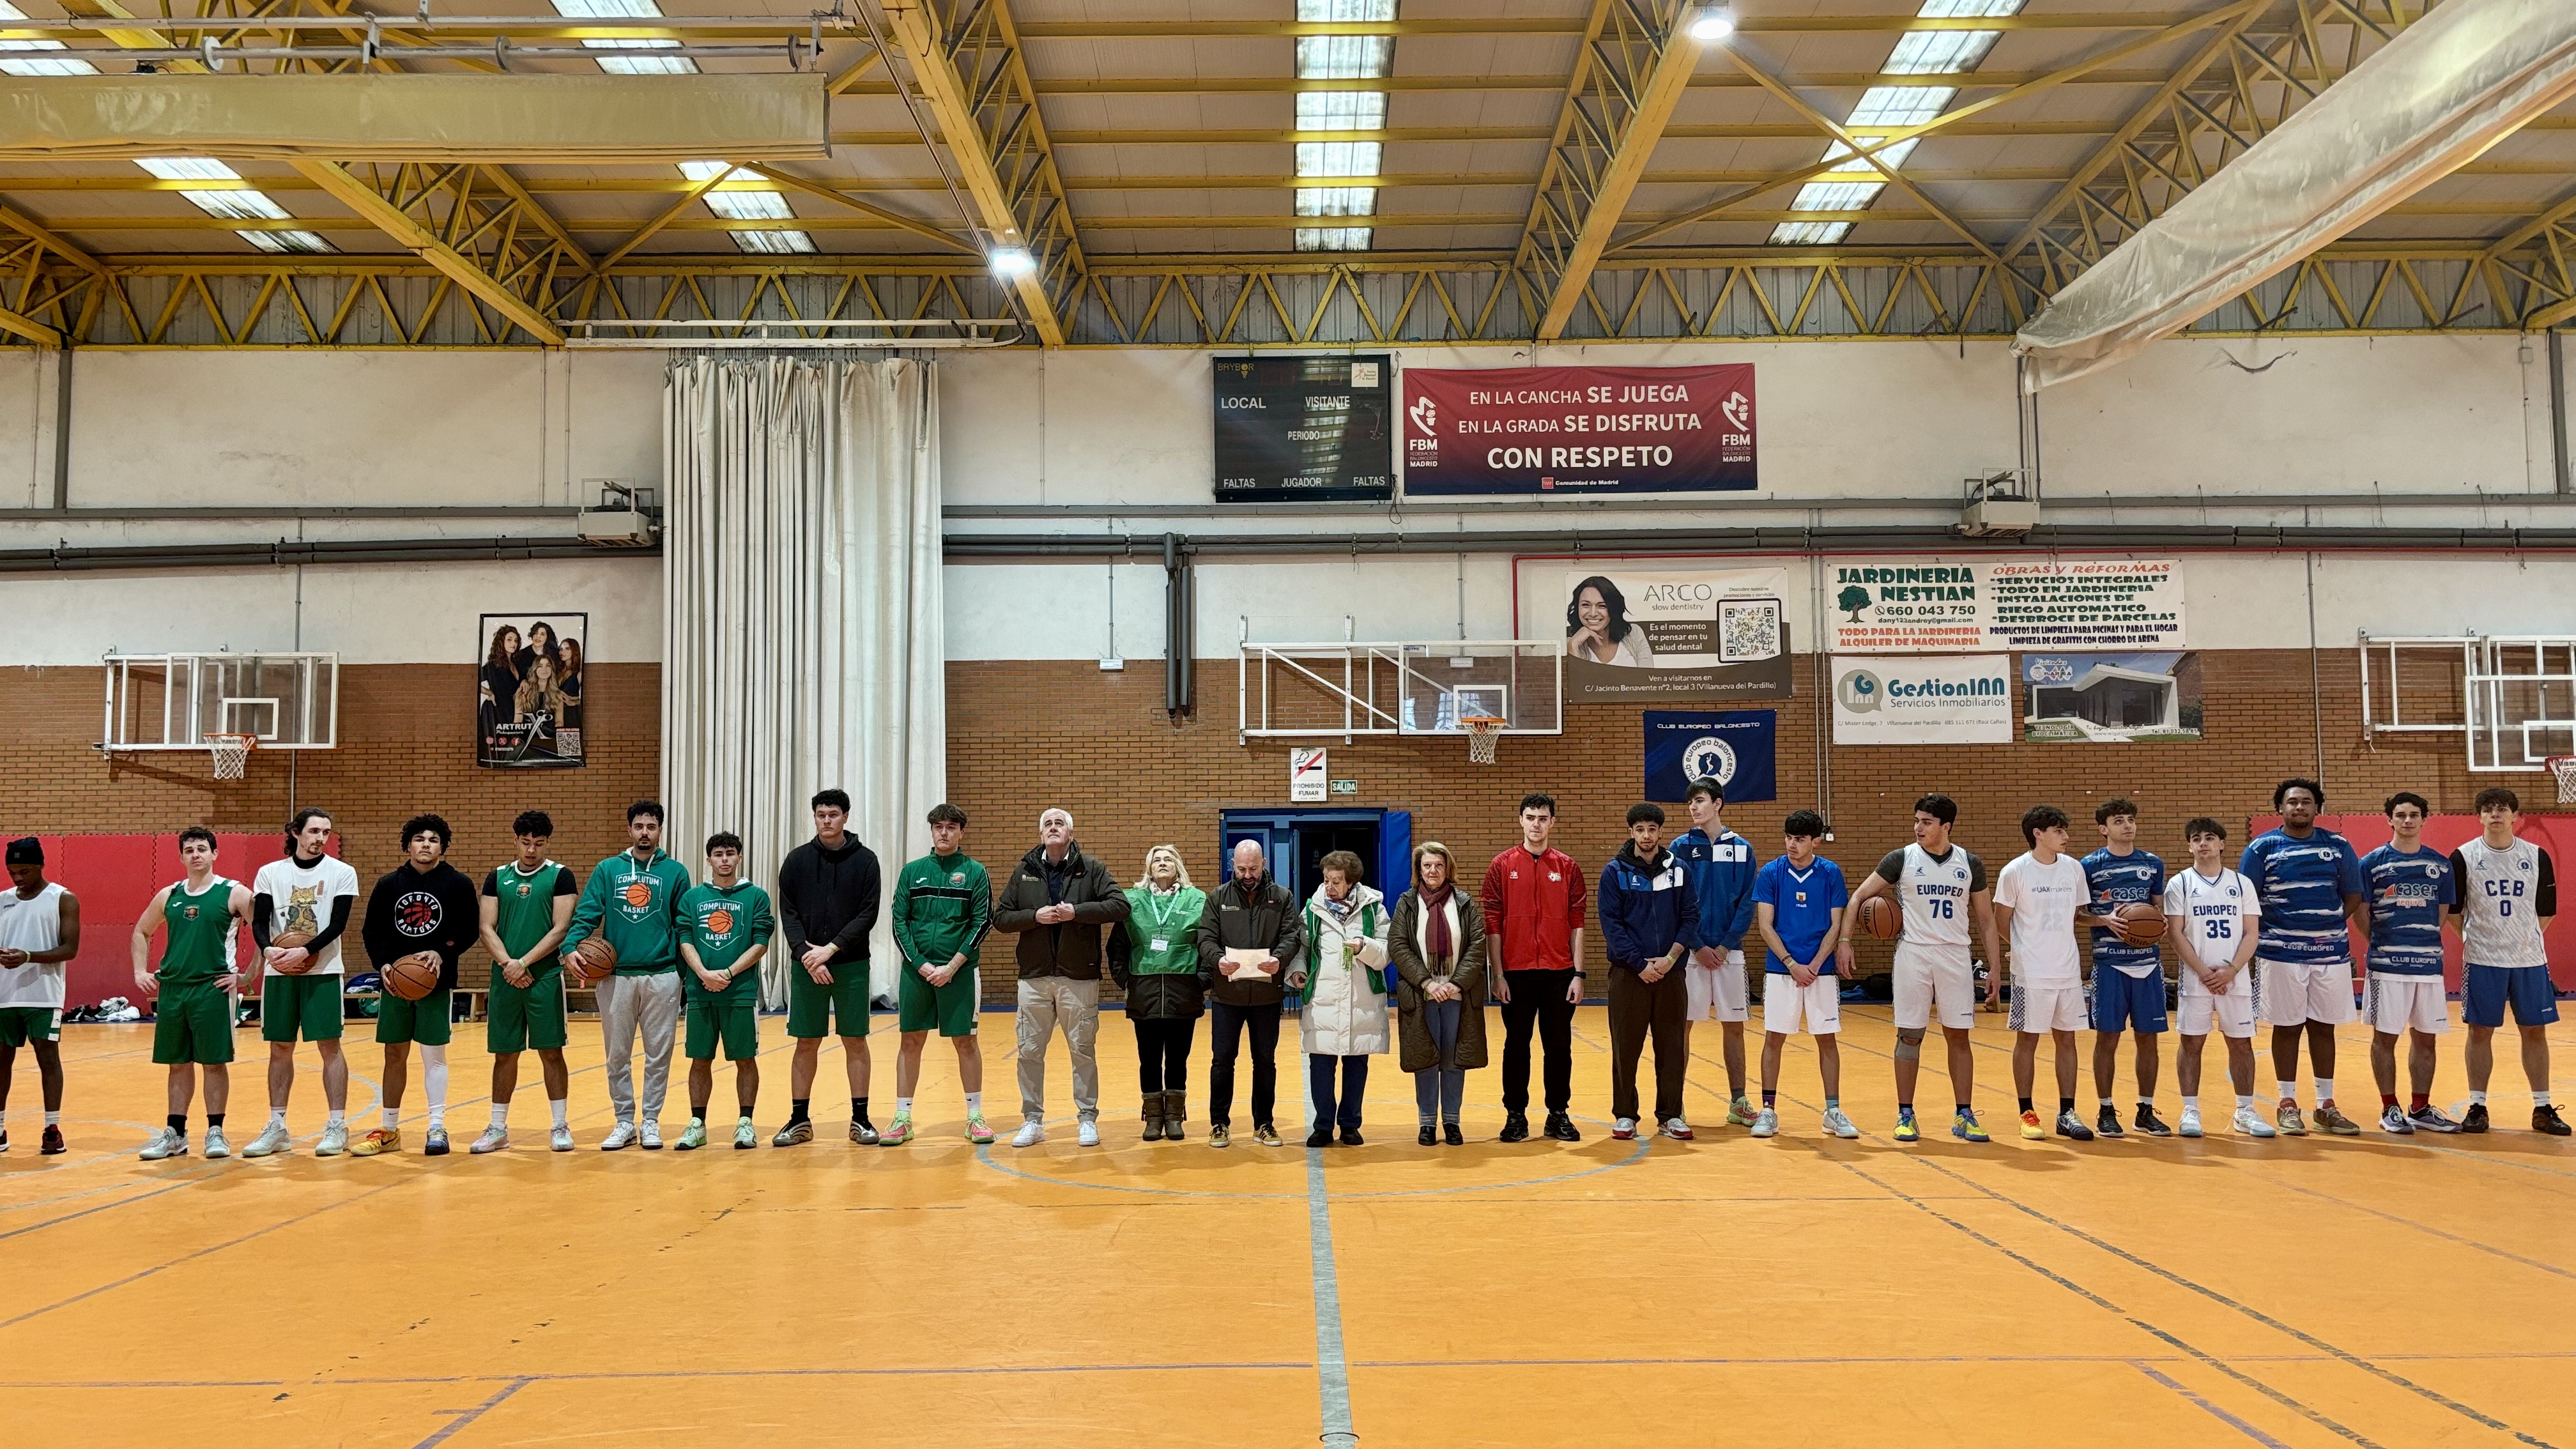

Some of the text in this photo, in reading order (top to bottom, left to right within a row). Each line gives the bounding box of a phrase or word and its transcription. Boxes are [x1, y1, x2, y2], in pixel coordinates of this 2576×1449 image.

[1470, 385, 1689, 405] EN LA CANCHA SE JUEGA
[1221, 396, 1350, 409] LOCAL VISITANTE
[1459, 413, 1702, 434] EN LA GRADA SE DISFRUTA
[1287, 431, 1320, 441] PERIODO
[1722, 434, 1751, 446] FBM
[1409, 439, 1438, 451] FBM
[1487, 445, 1673, 469] CON RESPETO
[1223, 476, 1385, 488] FALTAS JUGADOR FALTAS
[1837, 567, 1974, 584] JARDINERIA
[1993, 564, 2170, 576] OBRAS Y REFORMAS
[2078, 574, 2168, 583] INTEGRALES
[1643, 584, 1712, 602] ARCO
[1880, 586, 1975, 601] NESTIAN
[2064, 585, 2154, 593] JARDINERIA
[1652, 602, 1704, 612] slow dentistry
[1887, 605, 1975, 615] 660 043 750
[1997, 604, 2146, 614] RIEGO AUTOMATICO
[2102, 613, 2177, 622] PARCELAS
[1650, 623, 1659, 631] Es
[1660, 622, 1667, 631] el
[1837, 627, 1981, 636] TODO PARA LA JARDINERIA
[1989, 626, 2030, 634] PRODUCTOS
[2031, 626, 2040, 634] DE
[2074, 625, 2092, 634] PARA
[2154, 624, 2178, 632] HOGAR
[1660, 634, 1687, 643] pensar
[1839, 637, 1980, 647] ALQUILER DE MAQUINARIA
[2009, 636, 2041, 645] LIMPIEZA
[2052, 636, 2082, 644] GRAFITIS
[2098, 635, 2126, 643] CHORRO
[2138, 634, 2159, 643] ARENA
[1655, 643, 1676, 651] salud
[1747, 681, 1776, 689] Pardillo)
[1890, 697, 2005, 707] Servicios Inmobiliarios
[1686, 740, 1712, 762] europeo
[1713, 739, 1733, 779] baloncesto
[1332, 783, 1356, 792] SALIDA
[617, 875, 659, 886] COMPLUTUM
[1917, 884, 1963, 897] EUROPEO
[2395, 884, 2438, 898] caser
[2485, 879, 2525, 897] CEB
[622, 905, 649, 914] BASKET
[699, 902, 740, 912] COMPLUTUM
[1929, 900, 1953, 919] 76
[2193, 905, 2237, 916] EUROPEO
[2500, 900, 2511, 917] 0
[397, 919, 436, 934] RAPTORS
[2206, 919, 2231, 939] 35
[705, 932, 732, 940] BASKET
[1979, 970, 1988, 979] 22
